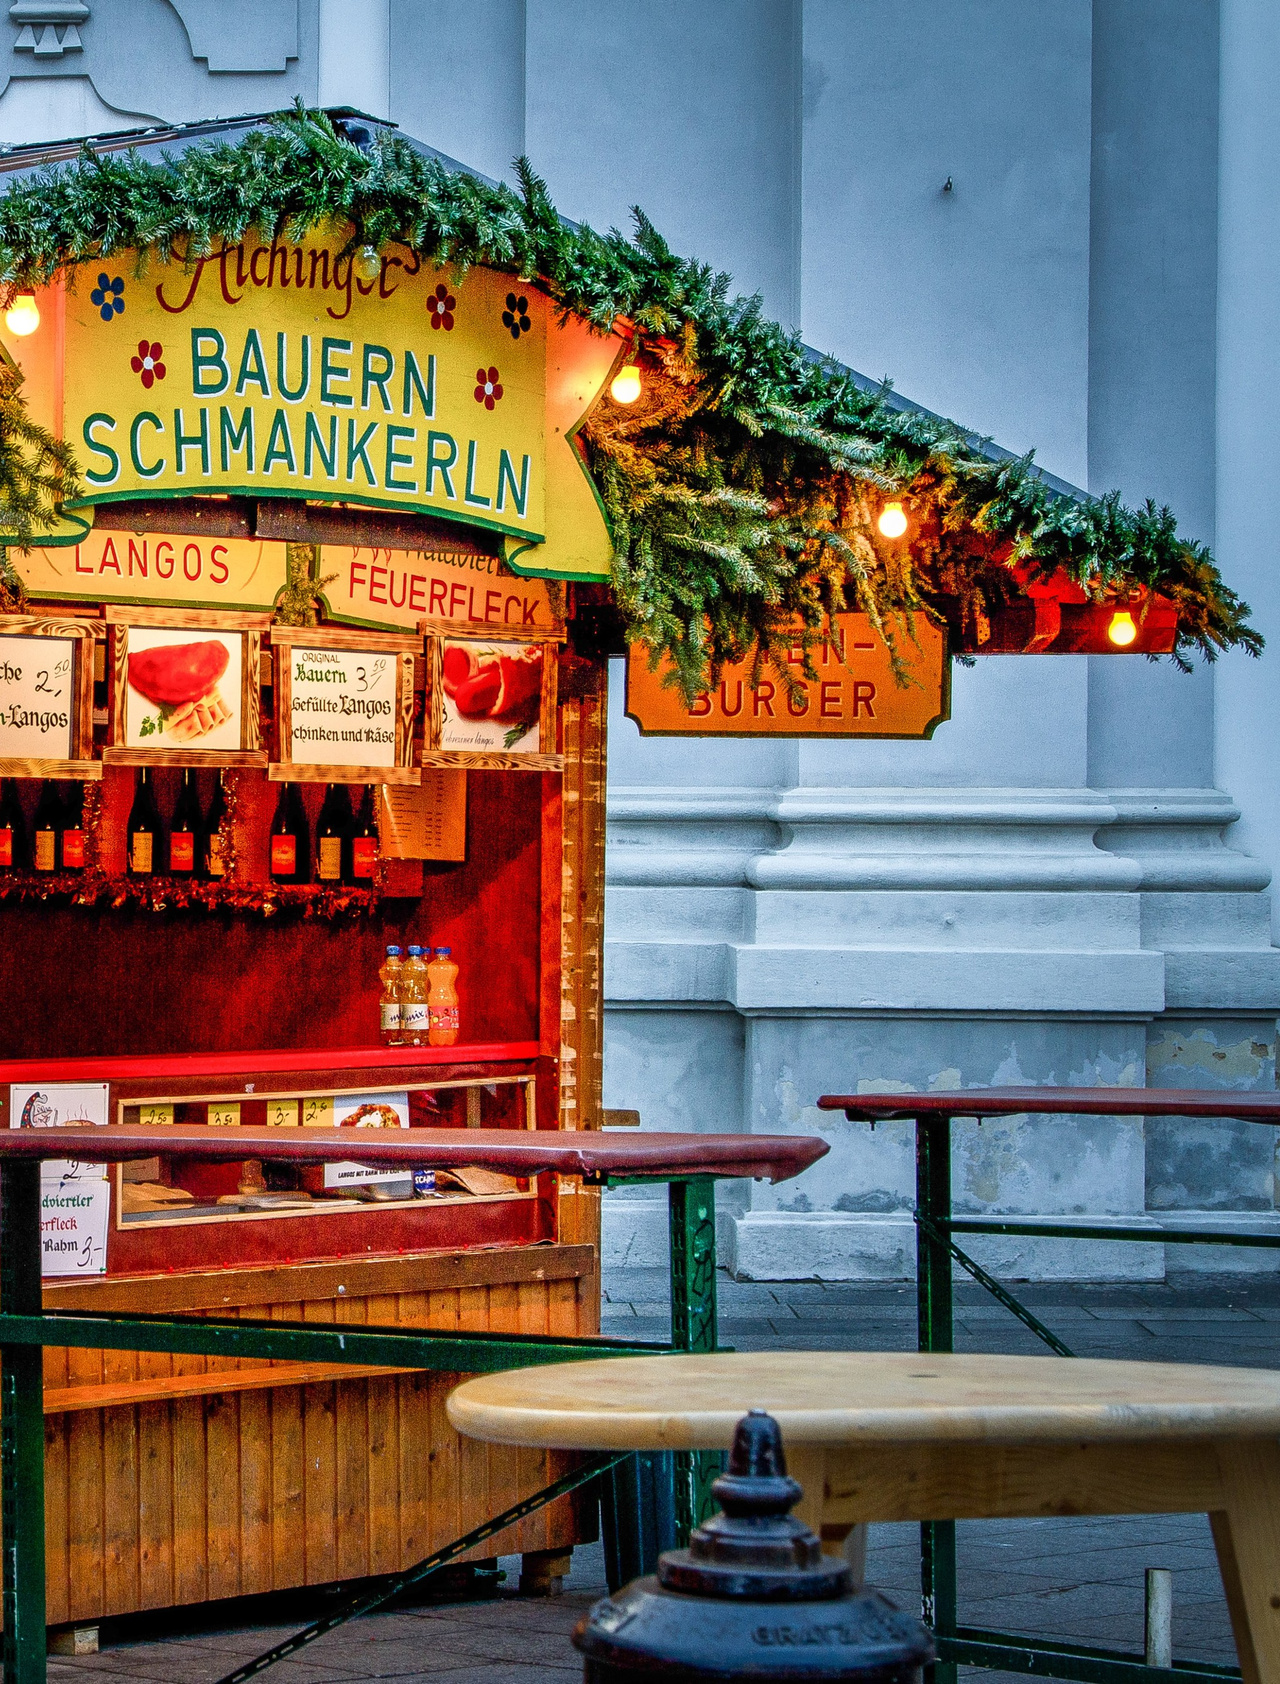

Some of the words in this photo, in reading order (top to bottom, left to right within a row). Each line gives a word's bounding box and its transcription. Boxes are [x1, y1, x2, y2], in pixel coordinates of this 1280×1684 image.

[191, 327, 437, 420] BAUERN
[82, 407, 531, 520] SCHMANKERLN
[75, 540, 230, 585] LANGOS
[349, 562, 542, 627] FEUERFLECK
[301, 652, 341, 664] ORIGINAL
[293, 662, 348, 684] Bauern
[291, 696, 338, 713] Gefüllte
[338, 694, 392, 720] Langos
[688, 680, 878, 719] BURGER
[341, 727, 363, 742] und
[363, 726, 395, 743] Käse
[41, 1194, 94, 1208] dviertler
[40, 1216, 77, 1231] erfleck
[42, 1238, 78, 1254] Rahm
